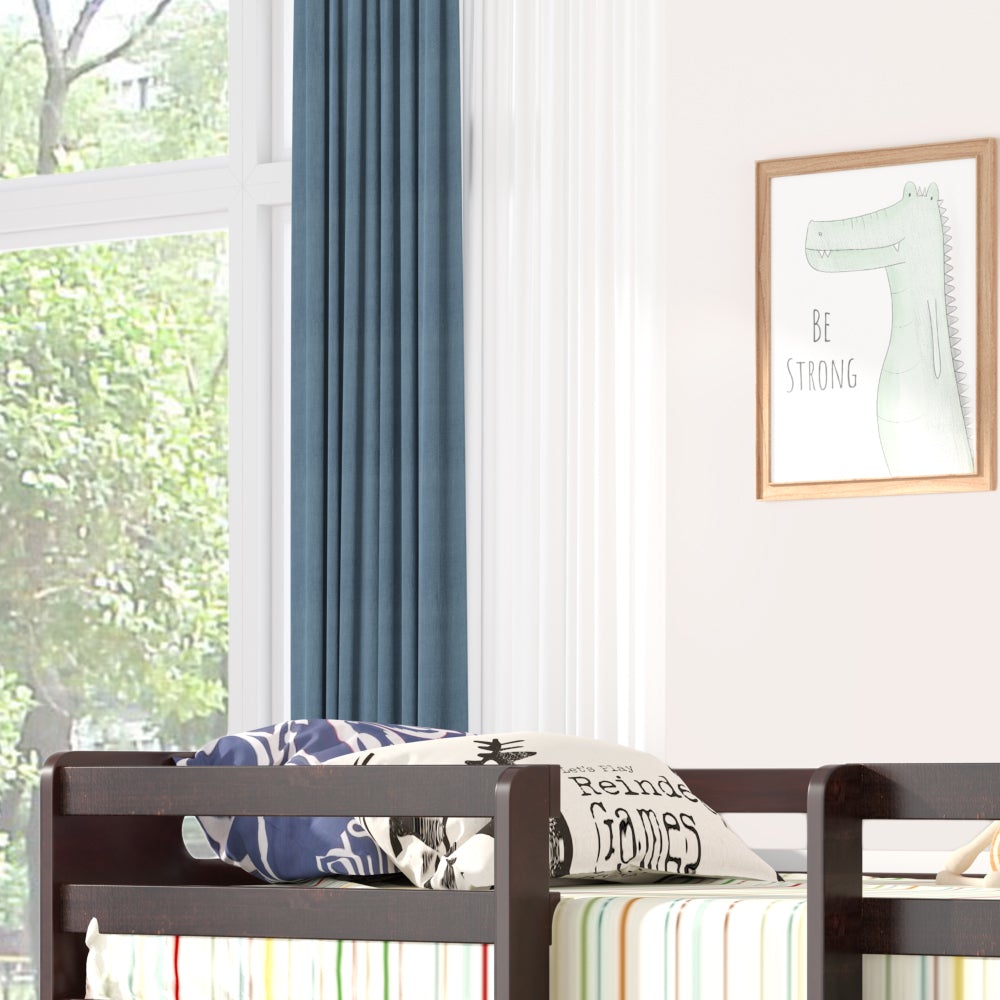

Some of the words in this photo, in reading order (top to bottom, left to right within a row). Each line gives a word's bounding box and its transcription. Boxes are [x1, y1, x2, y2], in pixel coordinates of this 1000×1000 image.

[812, 308, 831, 343] BE
[786, 358, 857, 393] STRONG
[598, 765, 634, 774] Play
[568, 775, 699, 803] Reinde
